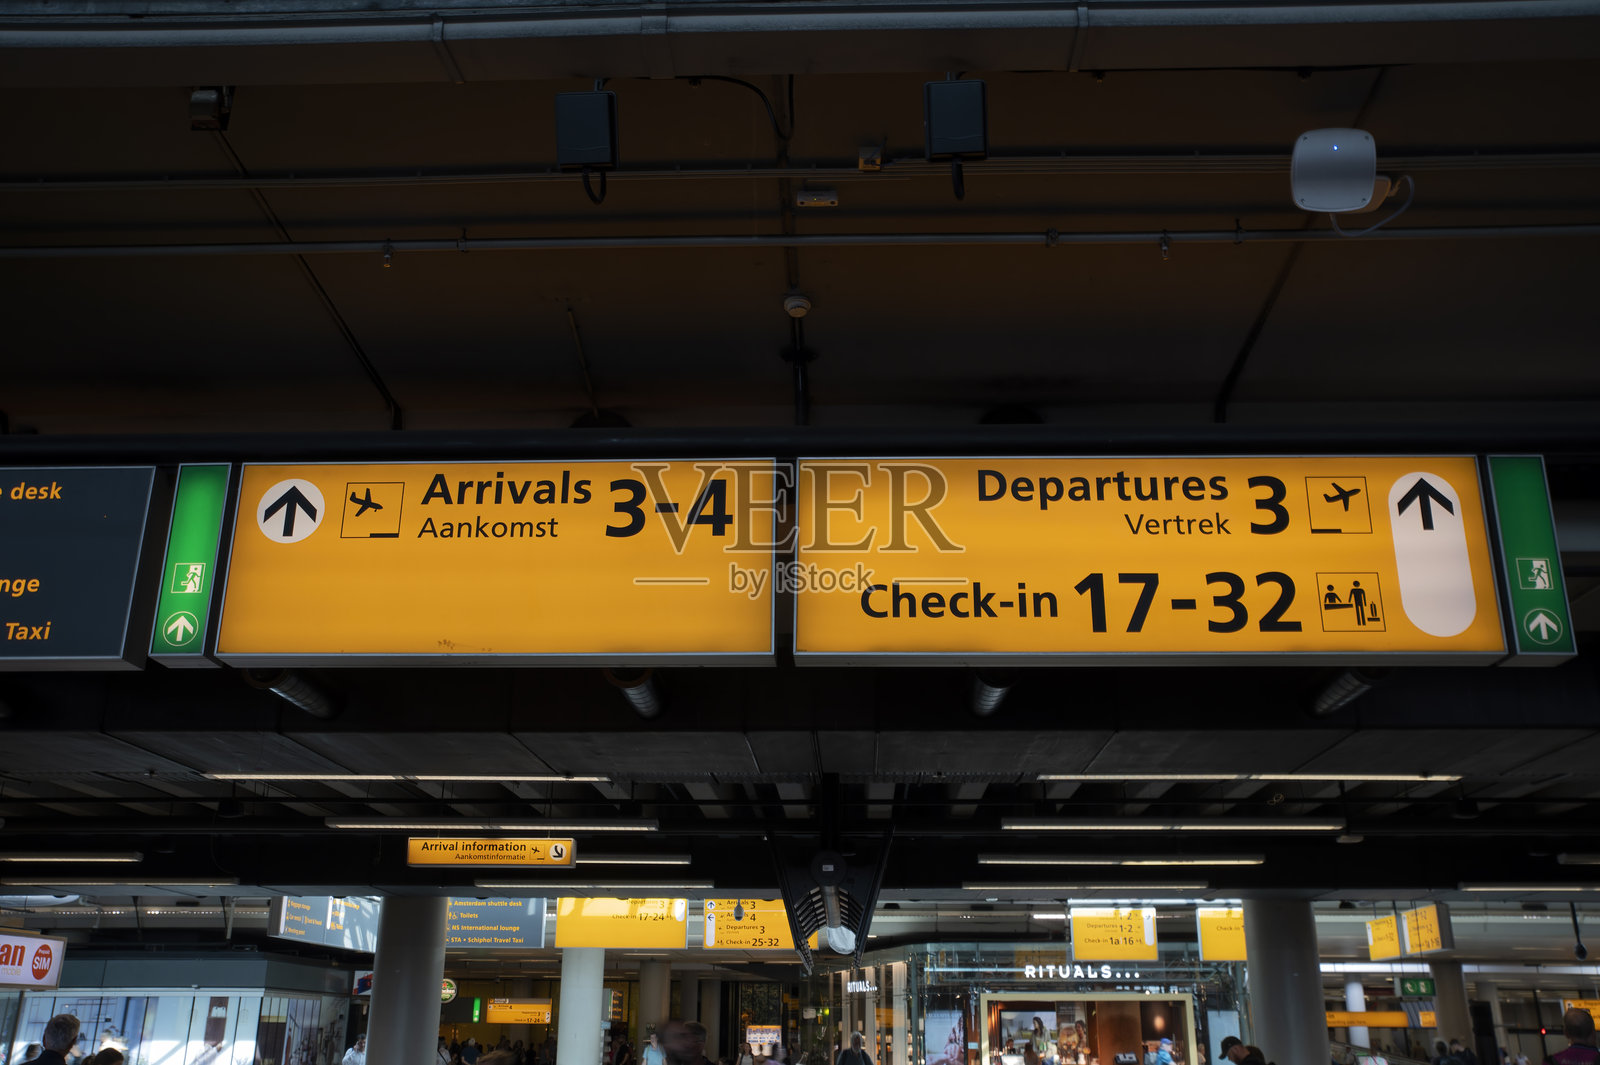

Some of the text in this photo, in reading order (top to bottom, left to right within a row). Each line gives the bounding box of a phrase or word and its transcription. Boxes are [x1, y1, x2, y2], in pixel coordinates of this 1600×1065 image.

[10, 481, 63, 500] desk
[977, 470, 1229, 511] Departures
[421, 470, 733, 538] Arrivals 3-4
[1247, 475, 1290, 534] 3
[417, 515, 559, 539] Aankomst
[1124, 512, 1231, 535] Vertrek
[860, 571, 1303, 634] Check-in 17-32
[6, 621, 52, 640] Taxi
[421, 841, 527, 851] Arrival information
[454, 853, 526, 861] Aankomstinformatie
[750, 901, 756, 910] 3
[639, 912, 665, 921] 17-24
[750, 913, 756, 921] 4
[499, 924, 520, 933] lounge
[759, 925, 766, 934] 3
[1119, 924, 1133, 933] 1-2
[752, 938, 780, 947] 25-32
[33, 955, 52, 970] SIM
[1024, 964, 1140, 979] RITUALS...
